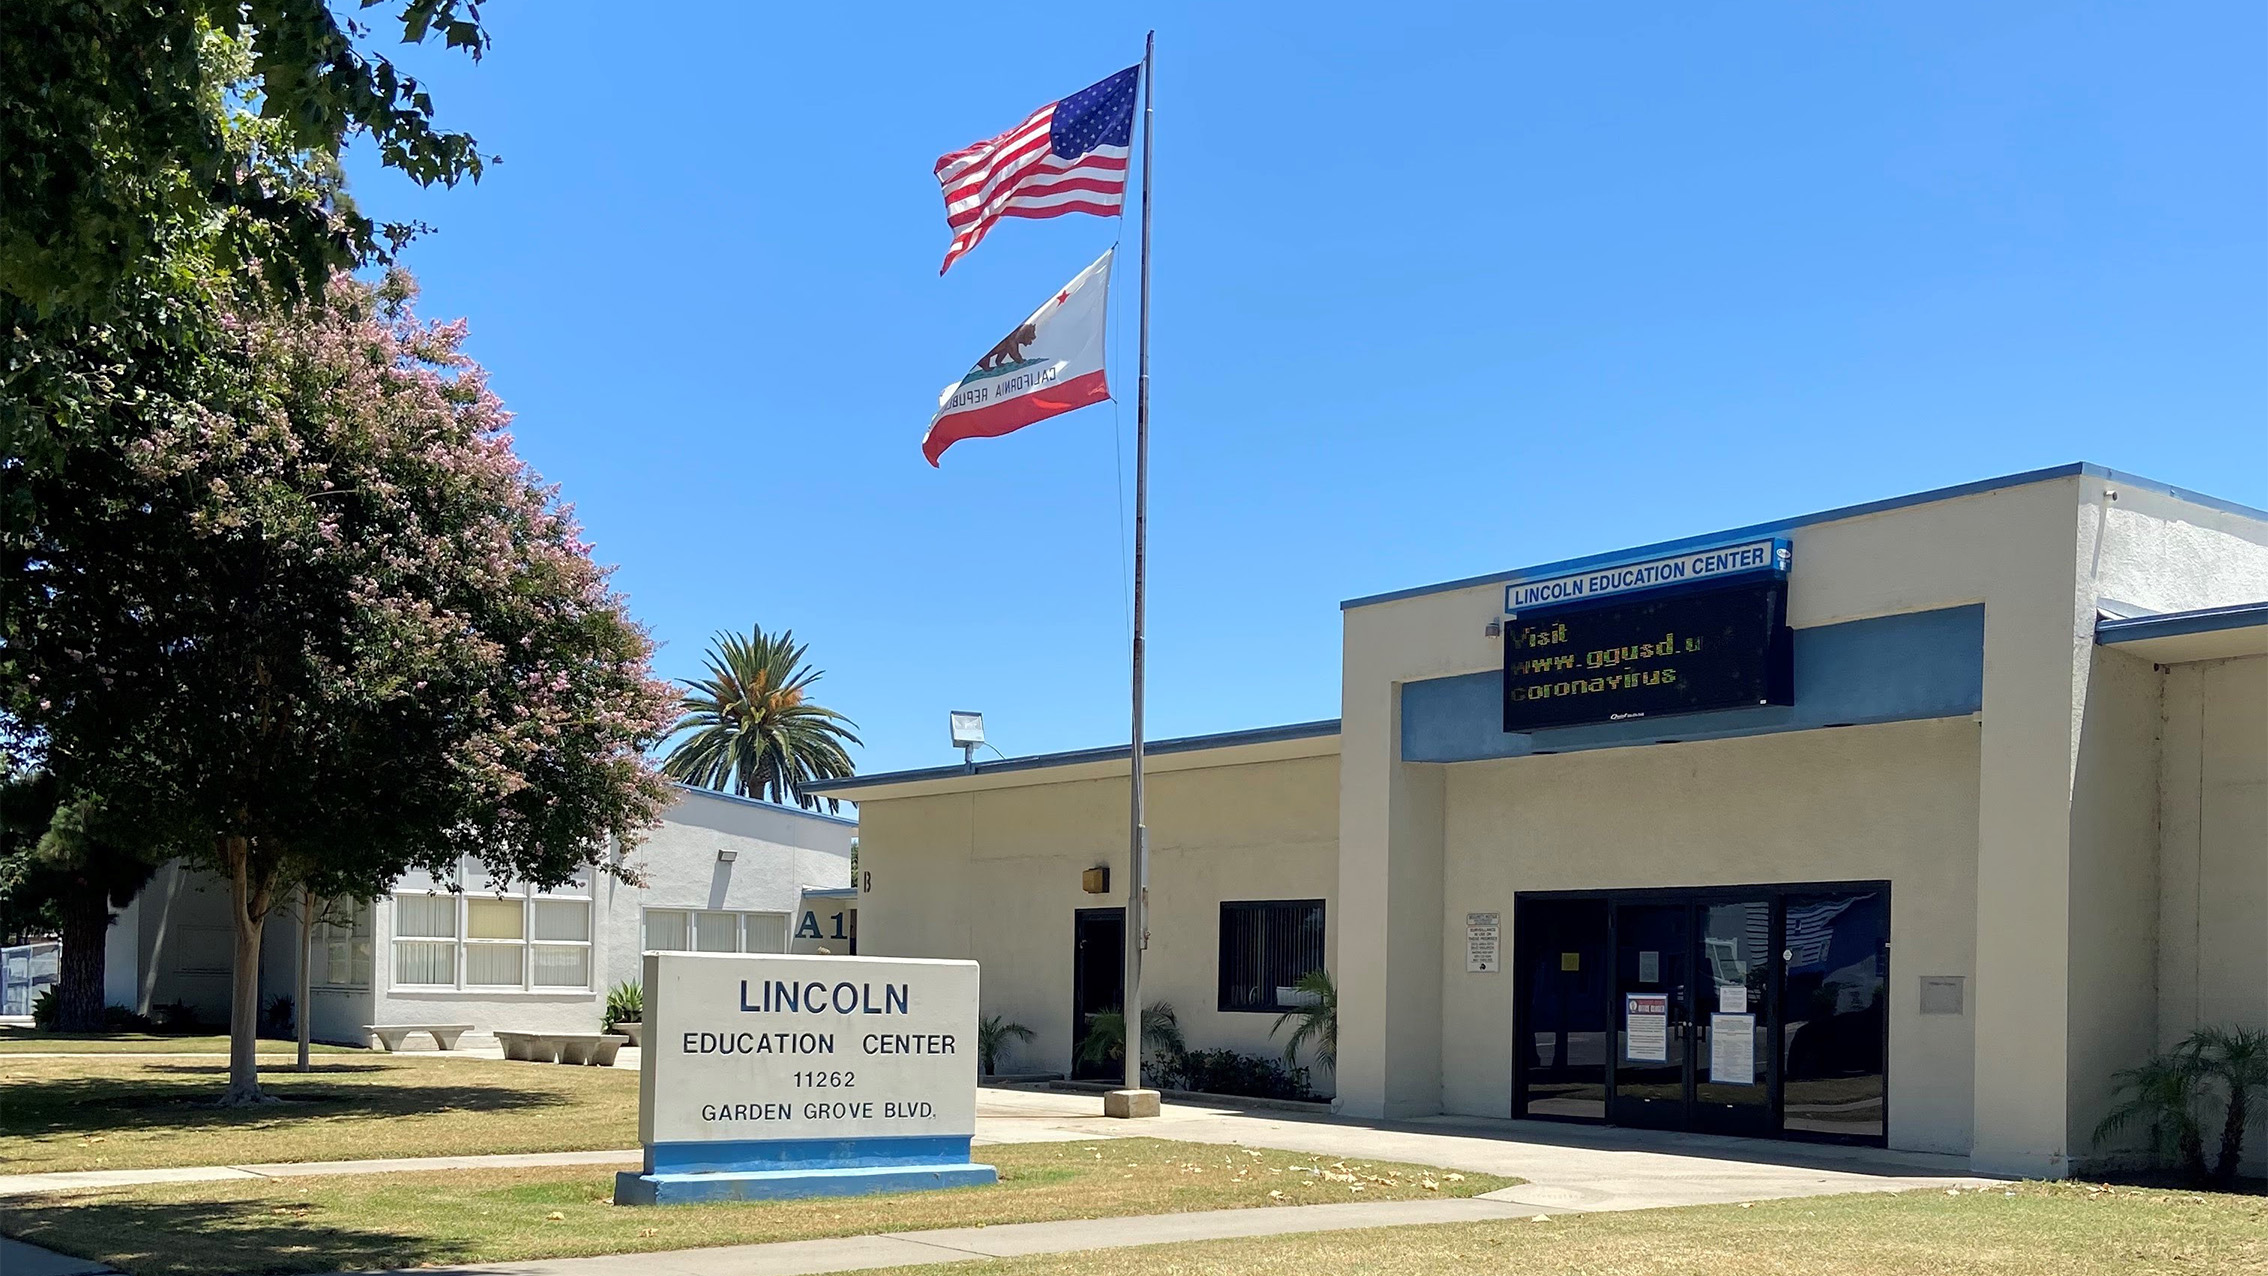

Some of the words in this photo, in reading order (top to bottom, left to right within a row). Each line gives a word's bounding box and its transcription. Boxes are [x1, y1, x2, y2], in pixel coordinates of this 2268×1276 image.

[1515, 579, 1583, 606] LINCOLN
[1589, 561, 1686, 593] EDUCATION
[1691, 548, 1764, 574] CENTER
[1511, 667, 1677, 701] coronavirus
[864, 871, 871, 893] B
[740, 980, 909, 1014] LINCOLN
[683, 1032, 834, 1055] EDUCATION
[863, 1034, 956, 1054] CENTER
[794, 1071, 855, 1088] 11262
[702, 1104, 791, 1121] GARDEN
[804, 1103, 873, 1119] GROVE
[884, 1102, 936, 1119] BLVD.
